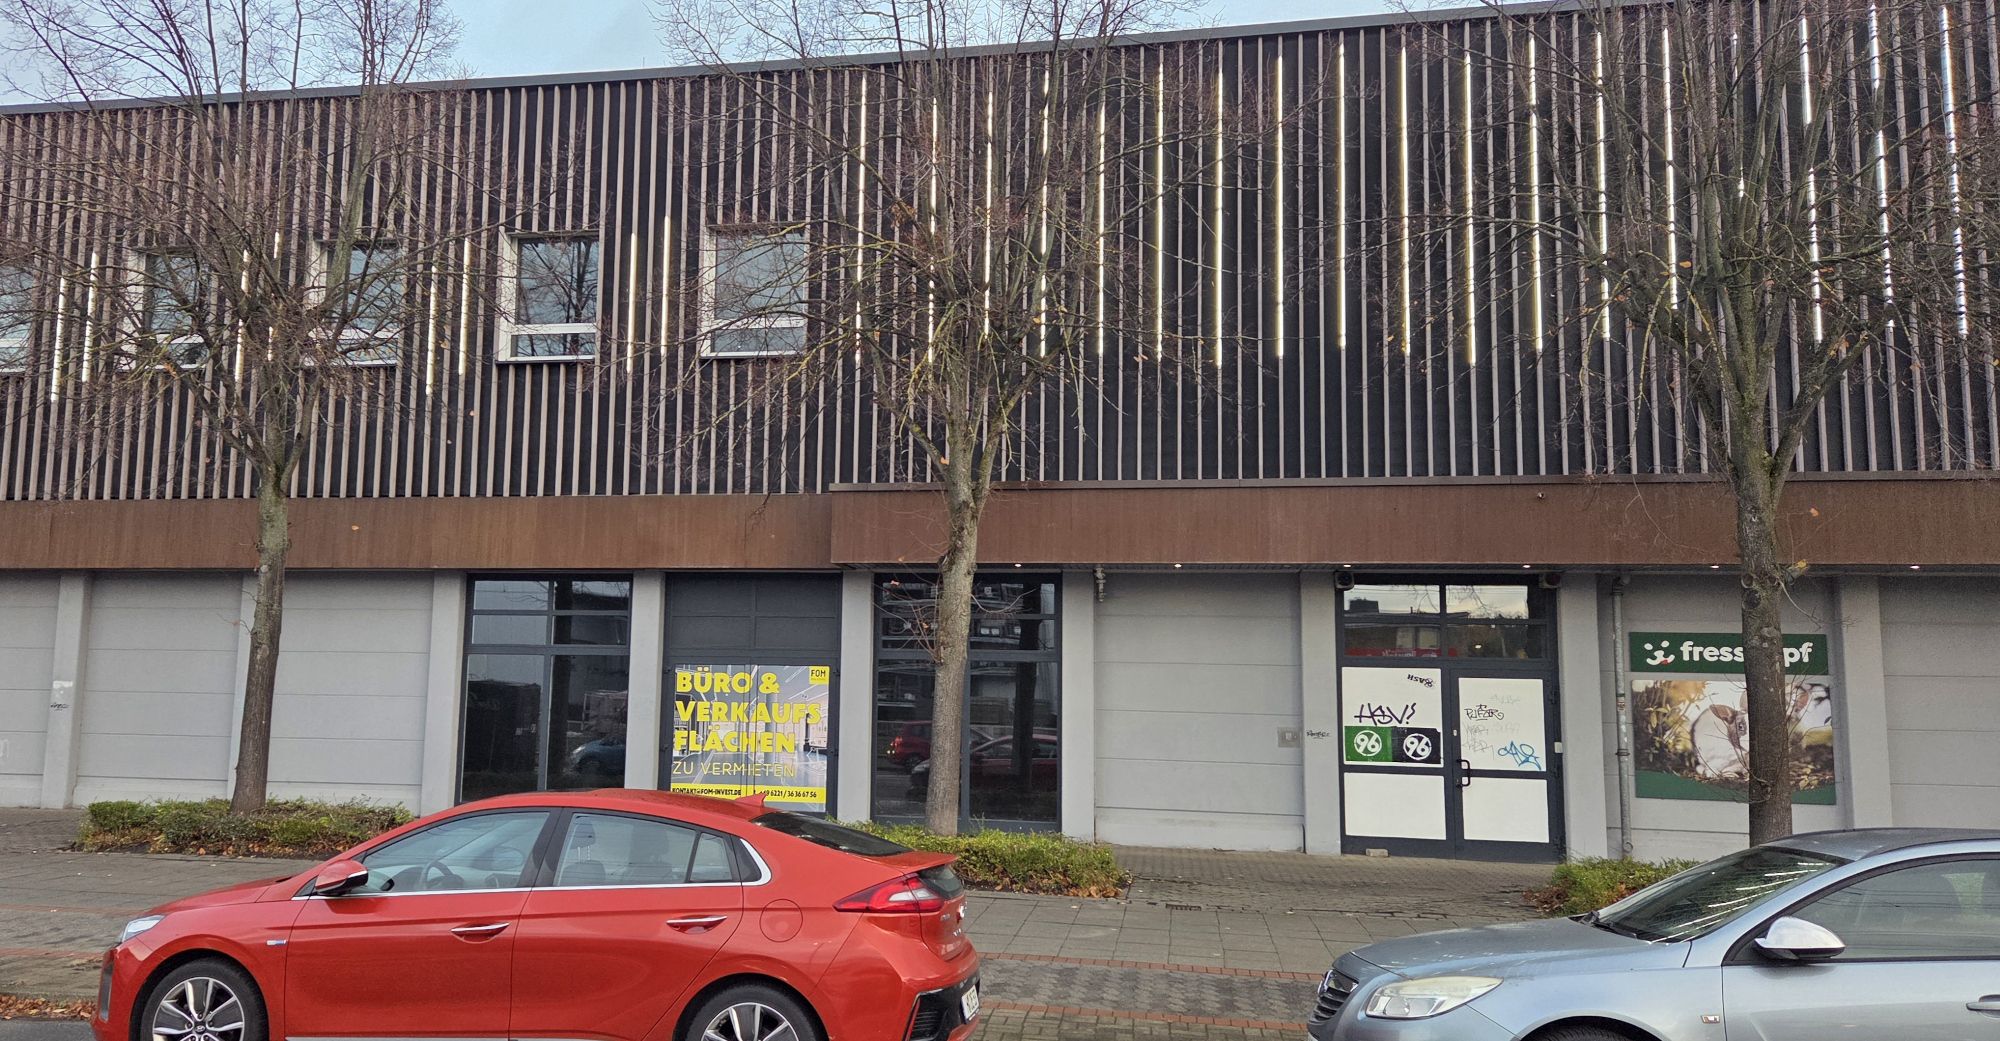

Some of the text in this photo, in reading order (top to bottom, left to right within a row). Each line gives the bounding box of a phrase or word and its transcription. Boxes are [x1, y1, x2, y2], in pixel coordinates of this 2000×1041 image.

[1680, 641, 1813, 667] fresspf
[676, 666, 780, 694] BÜRO &
[675, 701, 822, 724] VERKAUFS
[673, 725, 796, 753] FLÄCHEN
[672, 761, 796, 778] ZU VERMIETEN
